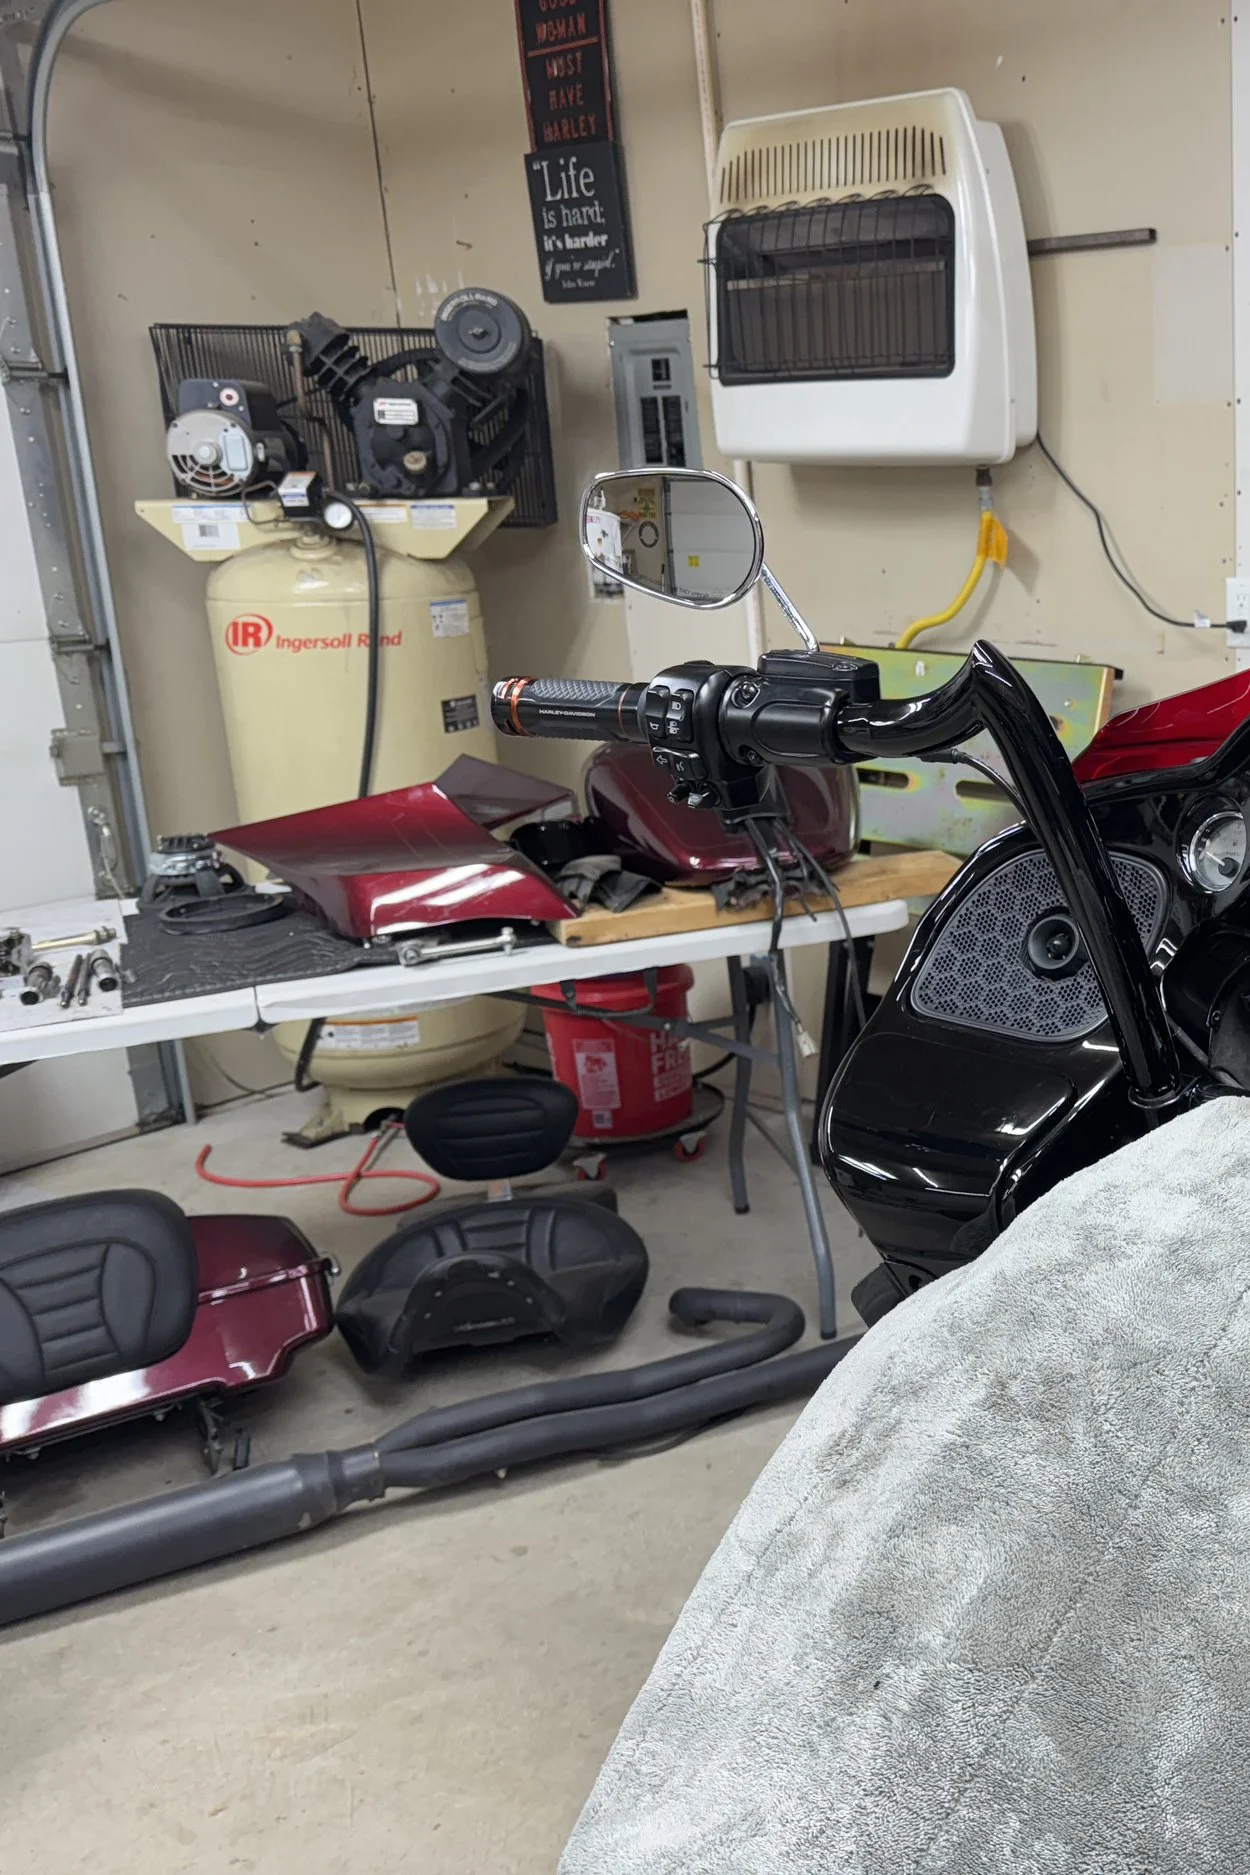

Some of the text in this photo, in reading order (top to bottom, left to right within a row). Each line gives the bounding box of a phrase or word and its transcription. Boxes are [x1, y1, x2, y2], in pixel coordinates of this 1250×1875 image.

[536, 12, 587, 44] WOMAN
[545, 51, 583, 80] MUST
[549, 82, 584, 111] HAVE
[543, 112, 597, 143] HARLEY
[542, 206, 557, 229] is
[543, 231, 608, 252] it's harder
[231, 620, 403, 654] IR Ingersoll Rnd
